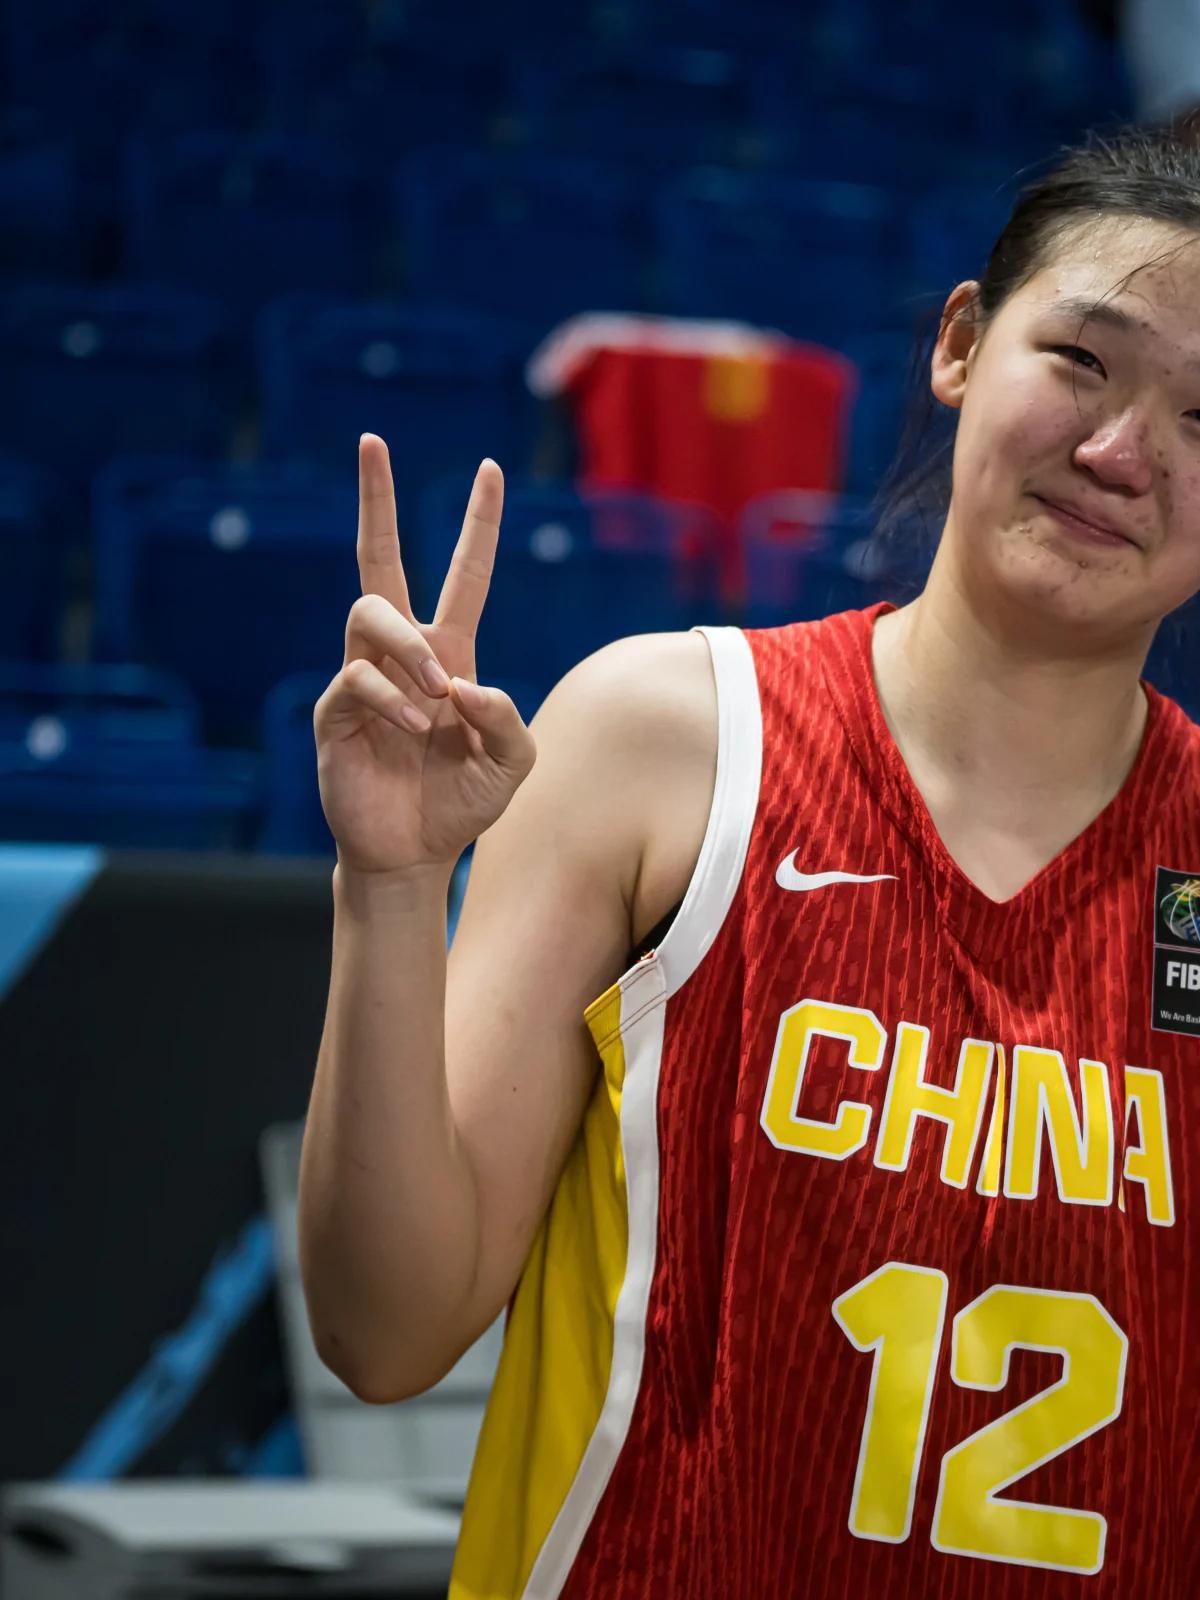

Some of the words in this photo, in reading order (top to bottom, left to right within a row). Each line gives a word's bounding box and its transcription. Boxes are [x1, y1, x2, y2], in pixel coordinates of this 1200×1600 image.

[759, 998, 1176, 1227] CHINA
[1160, 1010, 1172, 1020] We
[1173, 1012, 1185, 1022] Are
[831, 1261, 1129, 1575] 12
